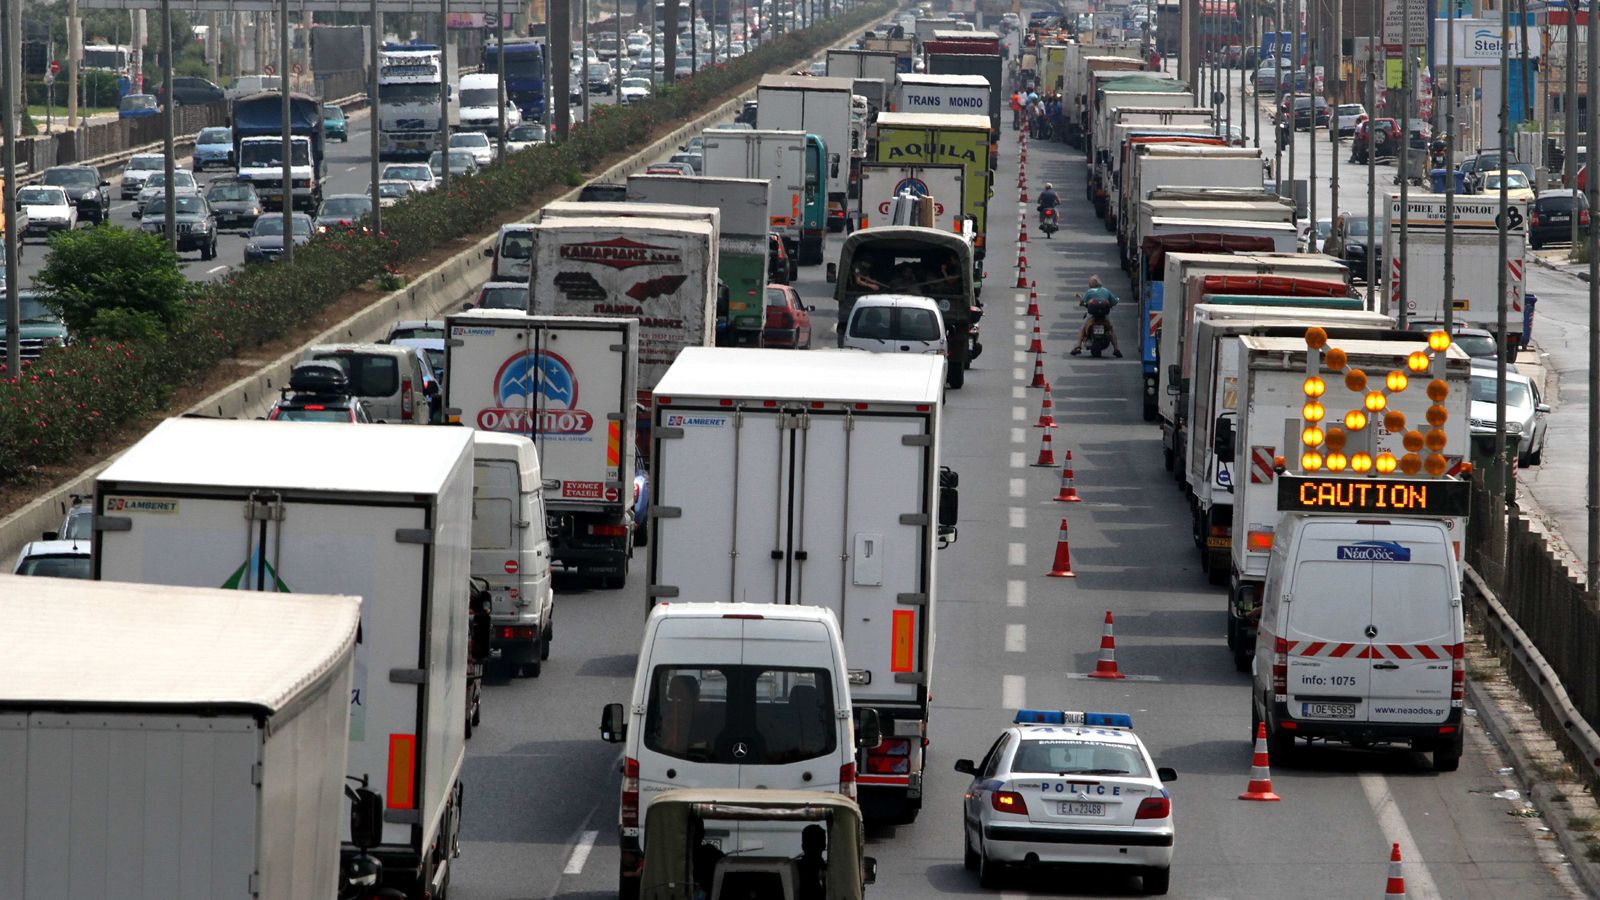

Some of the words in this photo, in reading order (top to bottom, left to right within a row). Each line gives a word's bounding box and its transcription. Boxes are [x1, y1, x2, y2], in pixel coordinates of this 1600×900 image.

[1474, 40, 1518, 51] Stelrt
[907, 95, 941, 106] TRANS
[949, 97, 983, 108] MONDO
[889, 143, 977, 163] AQUILA
[1393, 204, 1433, 213] OPHEE
[560, 245, 648, 260] ΚΑΜΑΡΙΔΗΣ
[682, 418, 726, 426] LAMBERET
[1300, 482, 1427, 509] CAUTION
[124, 501, 177, 510] LAMBERET
[1301, 674, 1327, 685] info:
[1330, 676, 1356, 686] 1075
[1374, 707, 1445, 717] www.neaodos.gr
[1065, 713, 1084, 724] POLICE
[1041, 782, 1121, 796] POLICE
